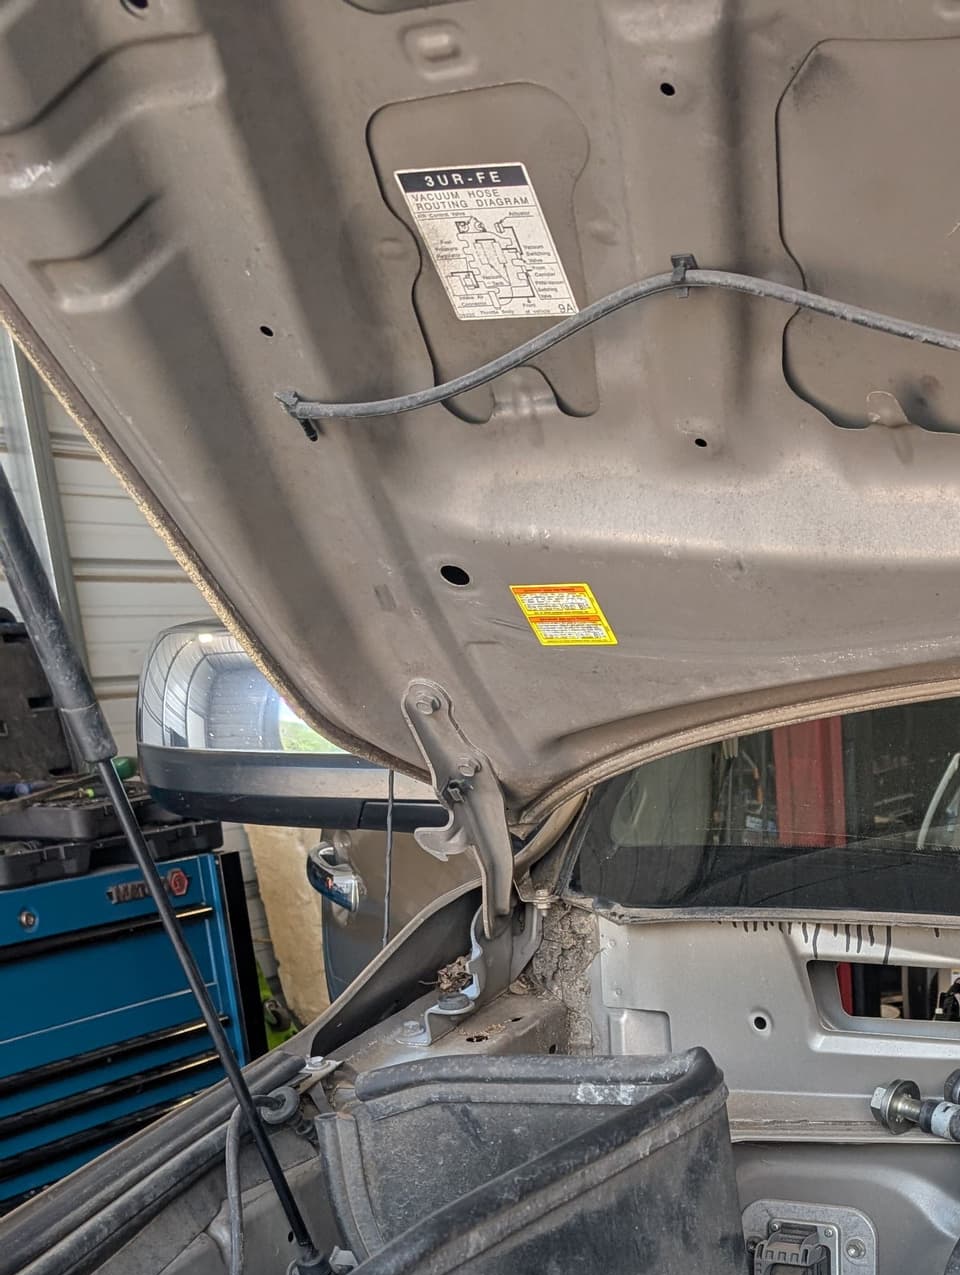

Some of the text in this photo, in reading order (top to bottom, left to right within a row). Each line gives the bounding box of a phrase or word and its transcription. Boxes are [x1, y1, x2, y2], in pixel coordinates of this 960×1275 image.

[424, 171, 502, 187] 3UR-FE
[411, 189, 499, 203] VACUUM HOSE
[417, 197, 529, 211] ROUTING DIAGRAM
